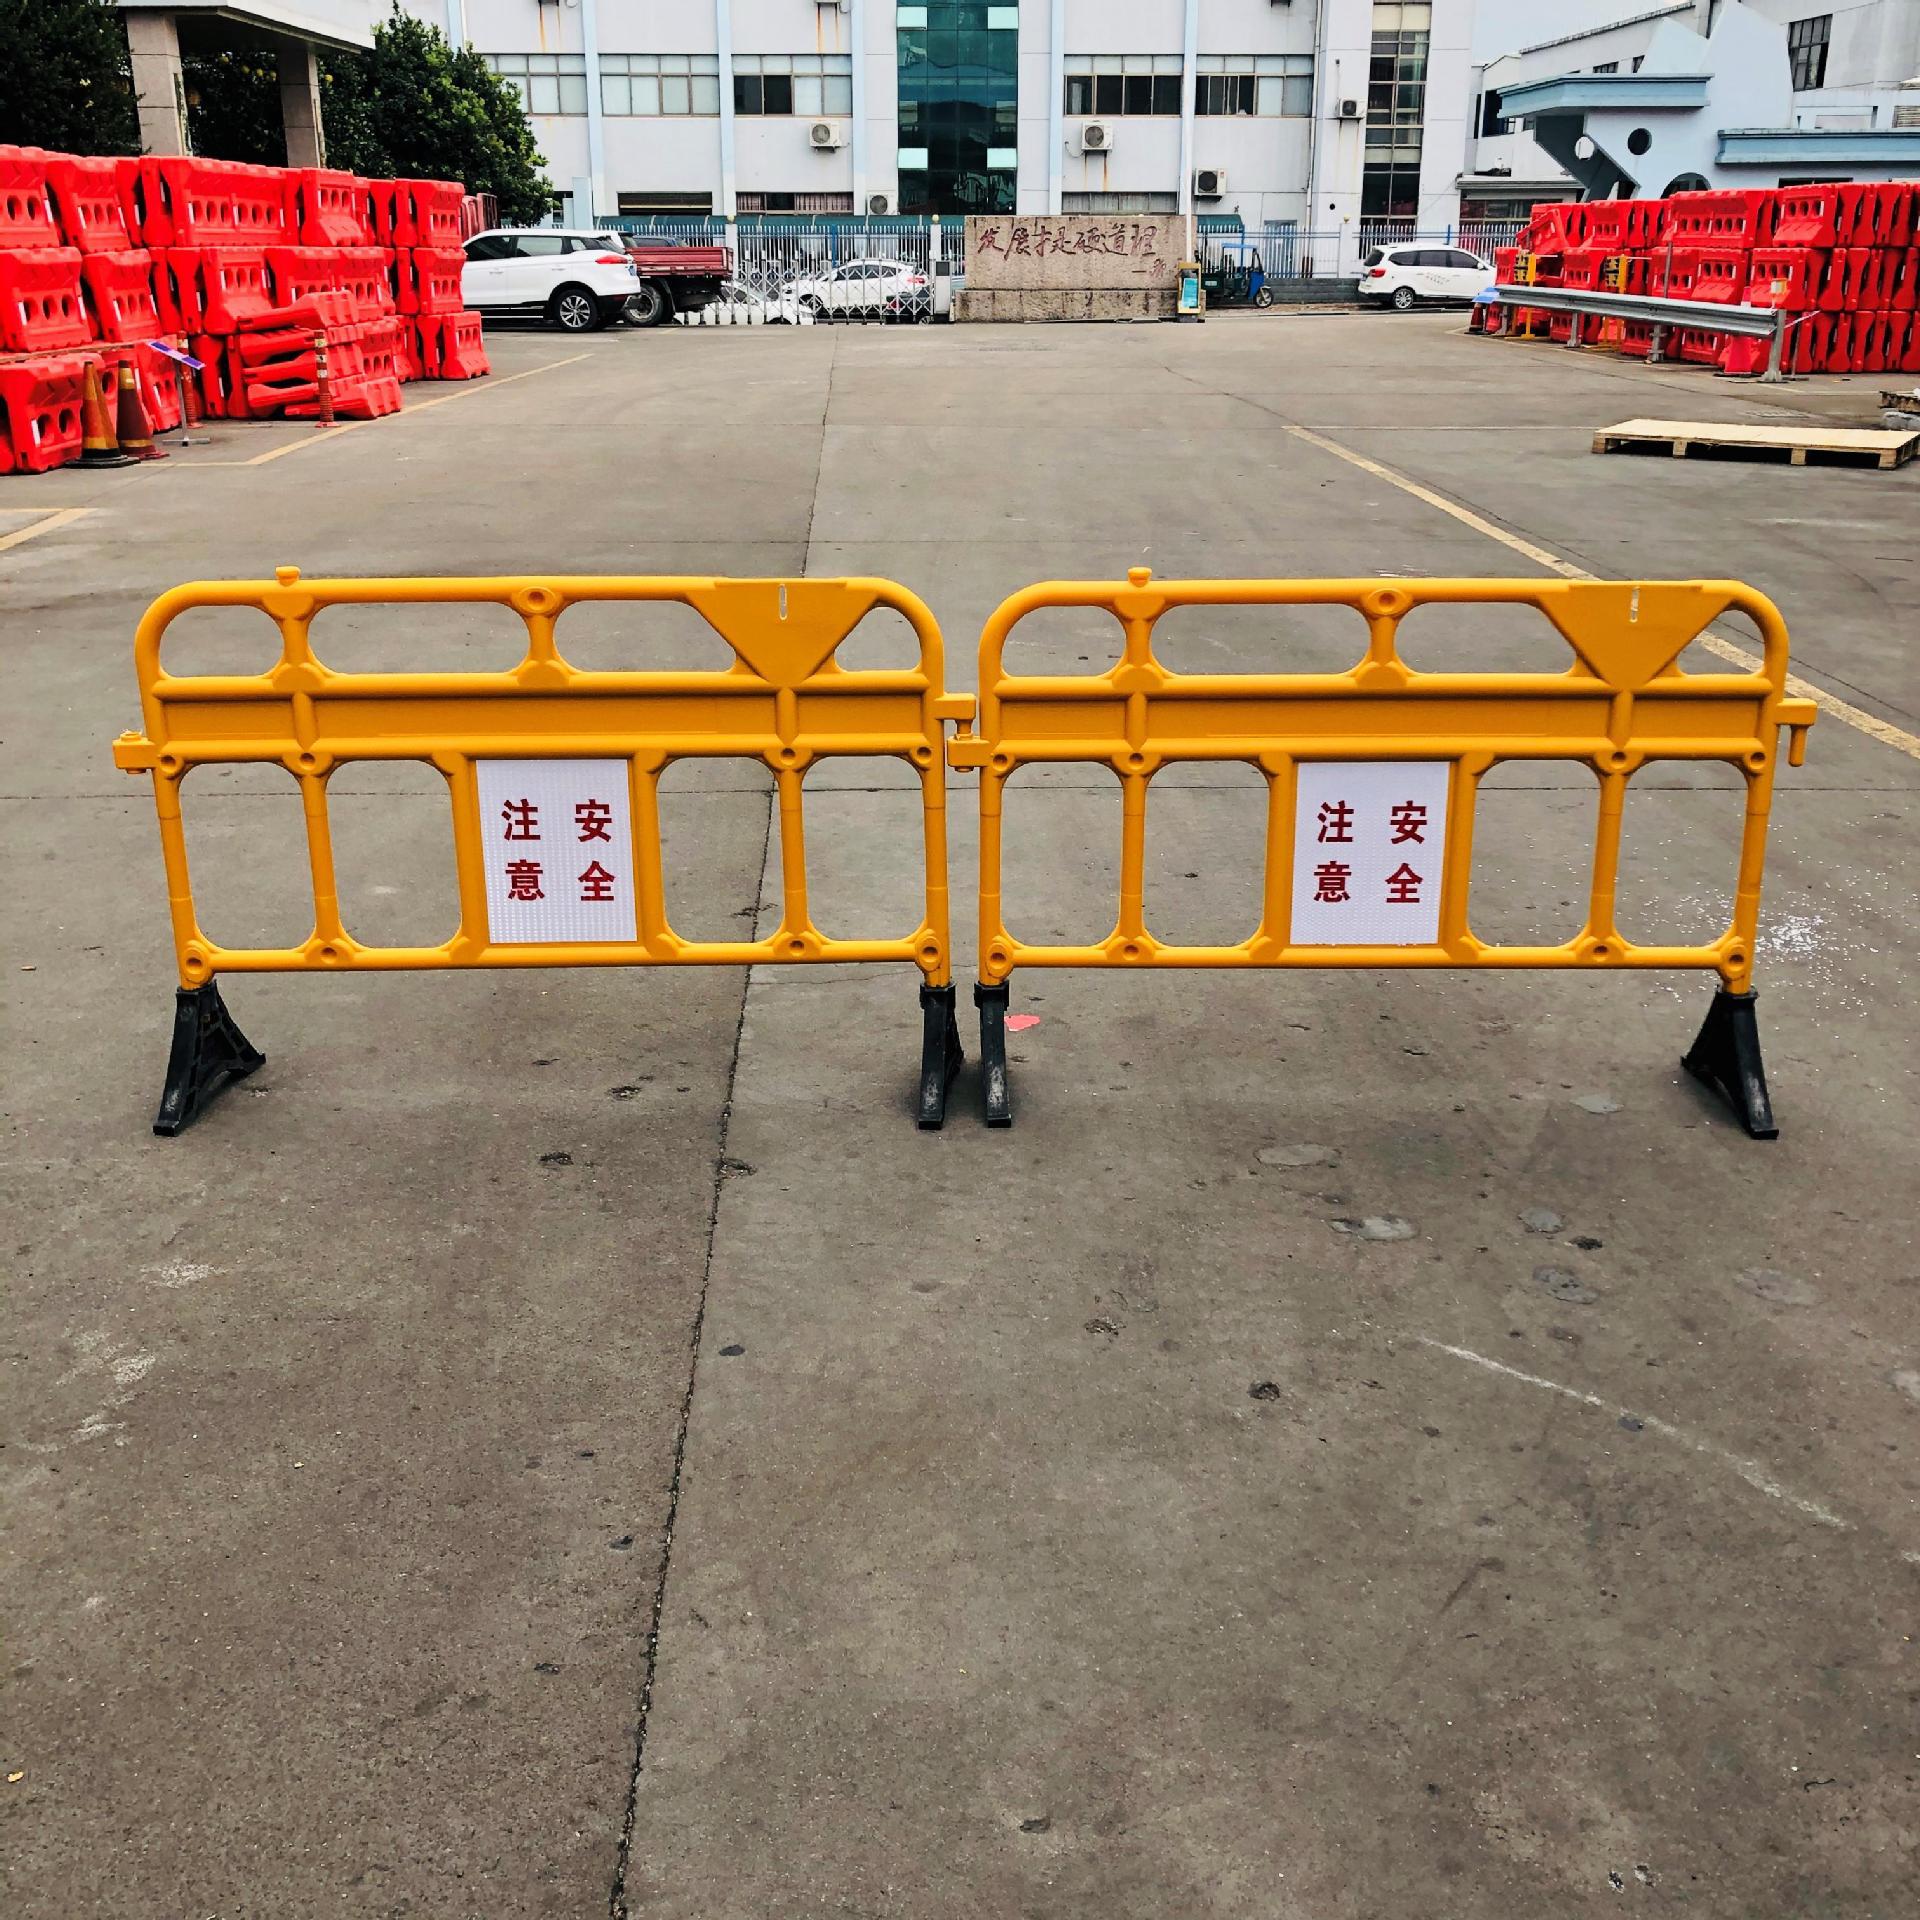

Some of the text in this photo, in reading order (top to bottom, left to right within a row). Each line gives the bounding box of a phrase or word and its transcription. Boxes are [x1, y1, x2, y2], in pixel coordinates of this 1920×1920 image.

[977, 223, 1158, 260] 发展才是硬道理
[501, 799, 545, 901] 注意
[575, 799, 616, 901] 安全
[1313, 800, 1354, 903] 注意
[1385, 800, 1427, 903] 安全
